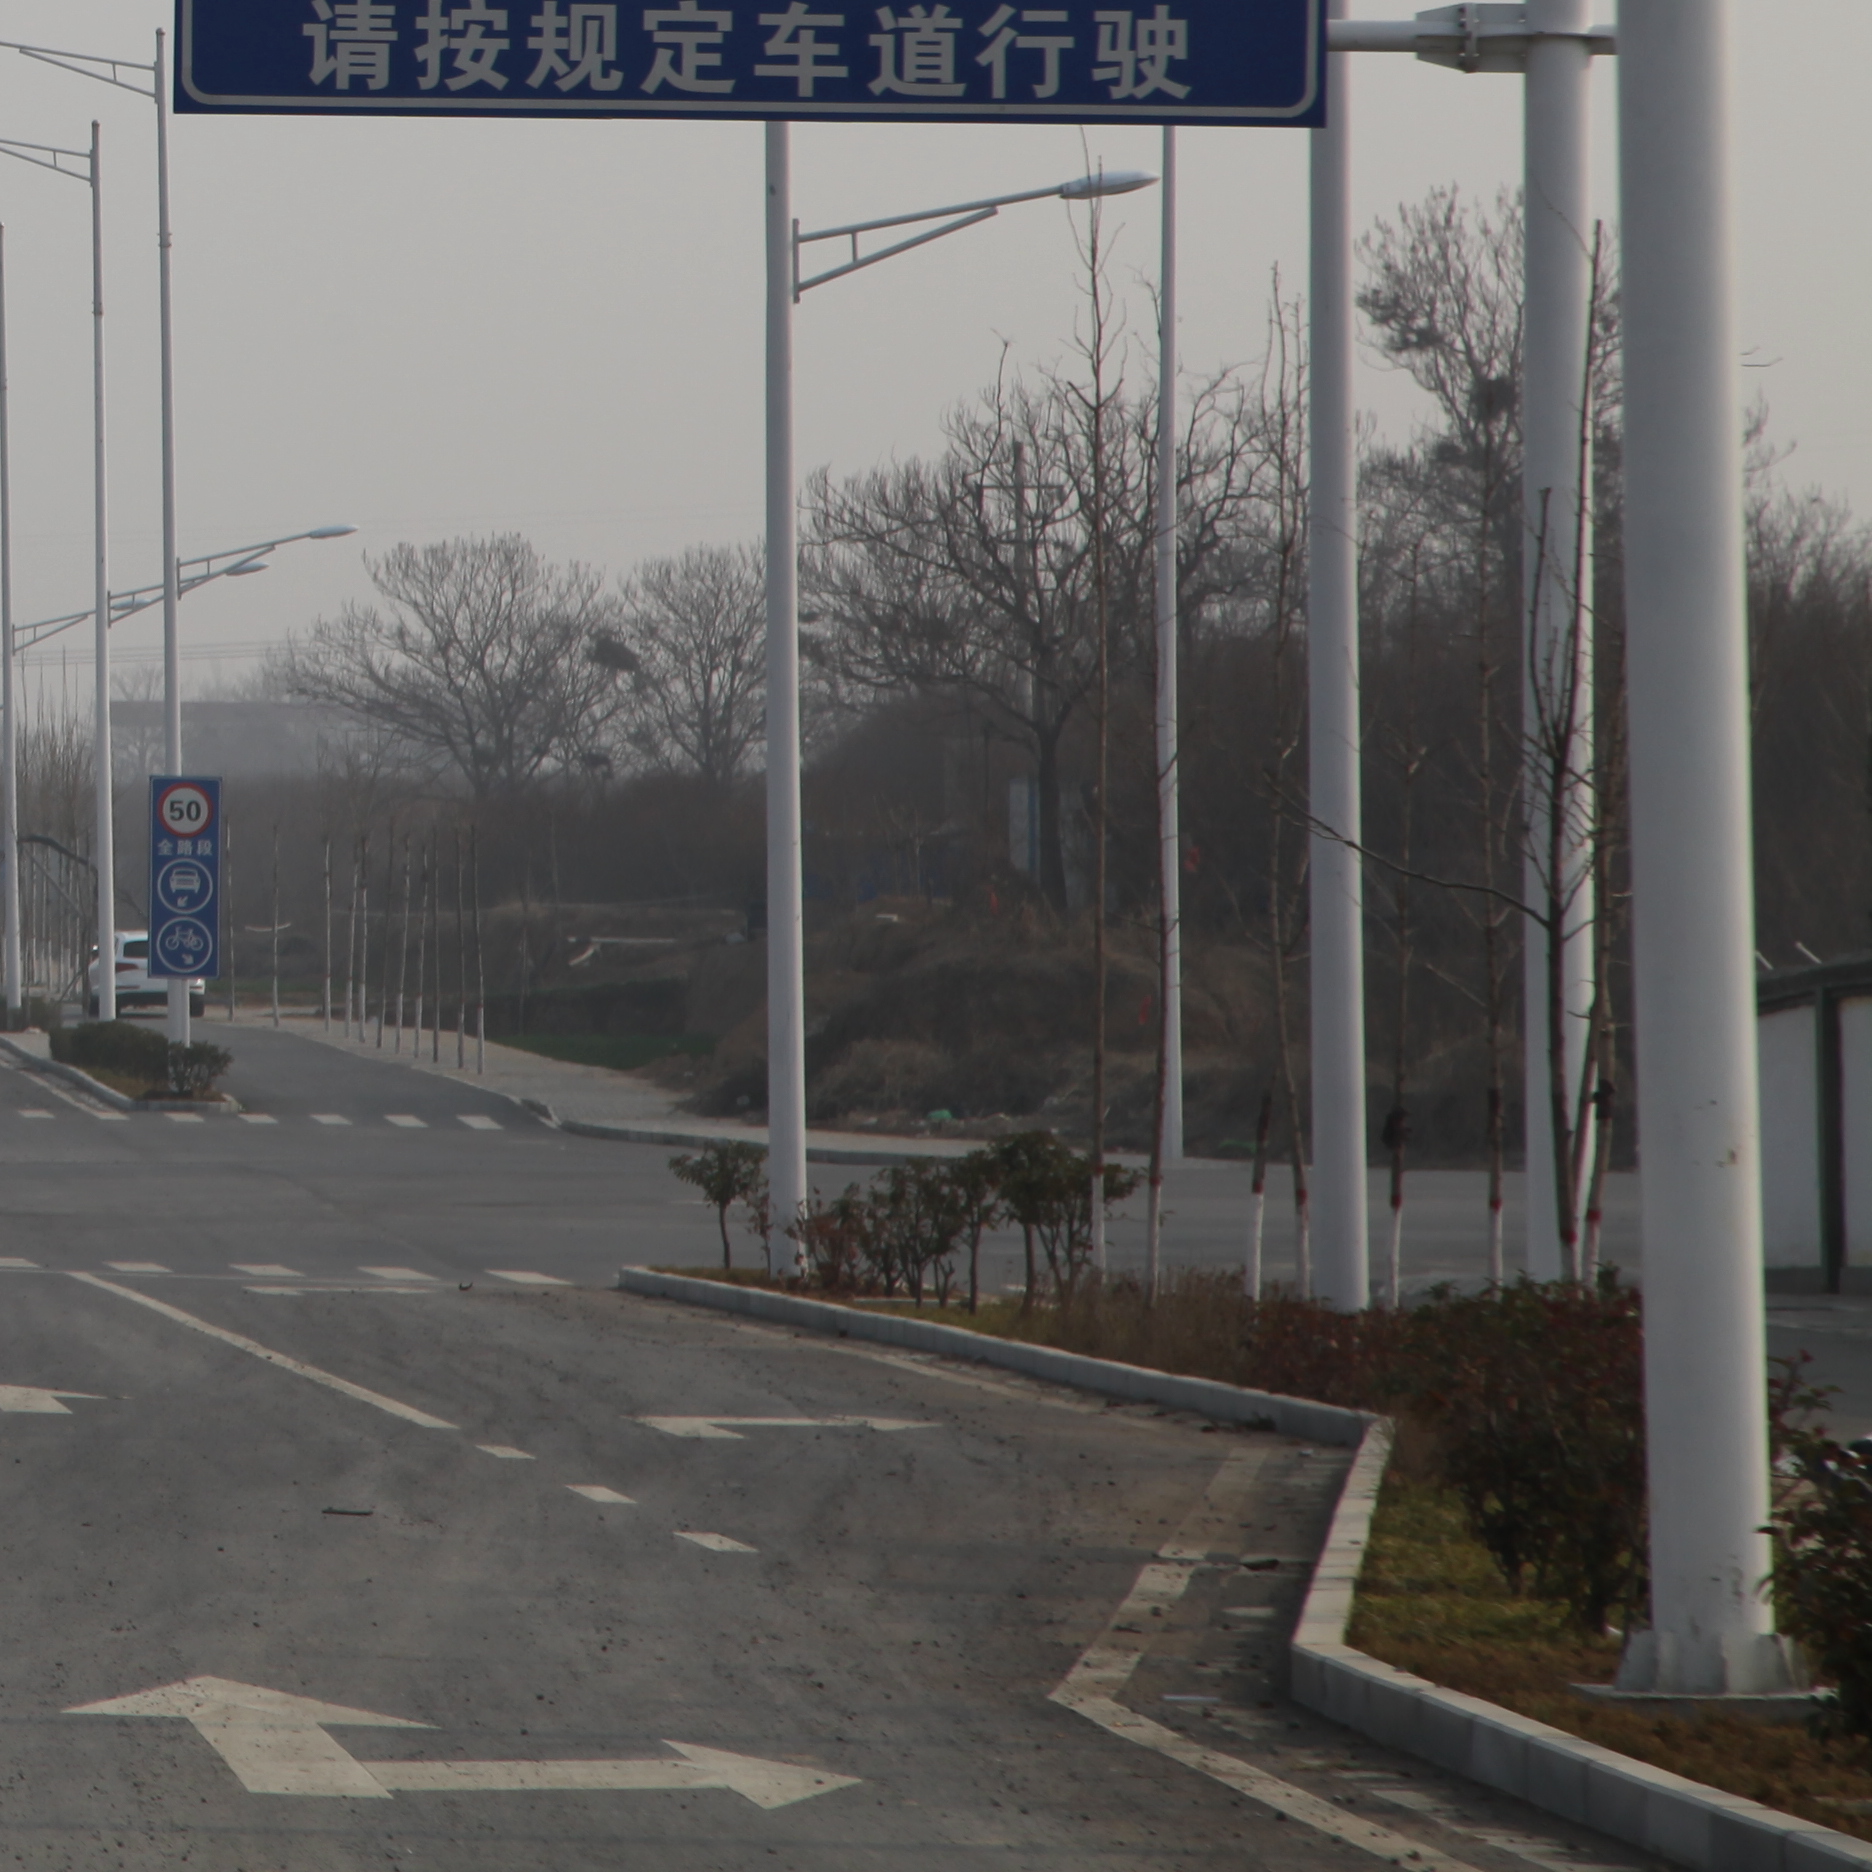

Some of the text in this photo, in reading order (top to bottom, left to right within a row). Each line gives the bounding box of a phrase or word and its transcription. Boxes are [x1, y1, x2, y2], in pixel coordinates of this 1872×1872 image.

[169, 799, 202, 822] 50
[157, 838, 213, 856] 全路段
